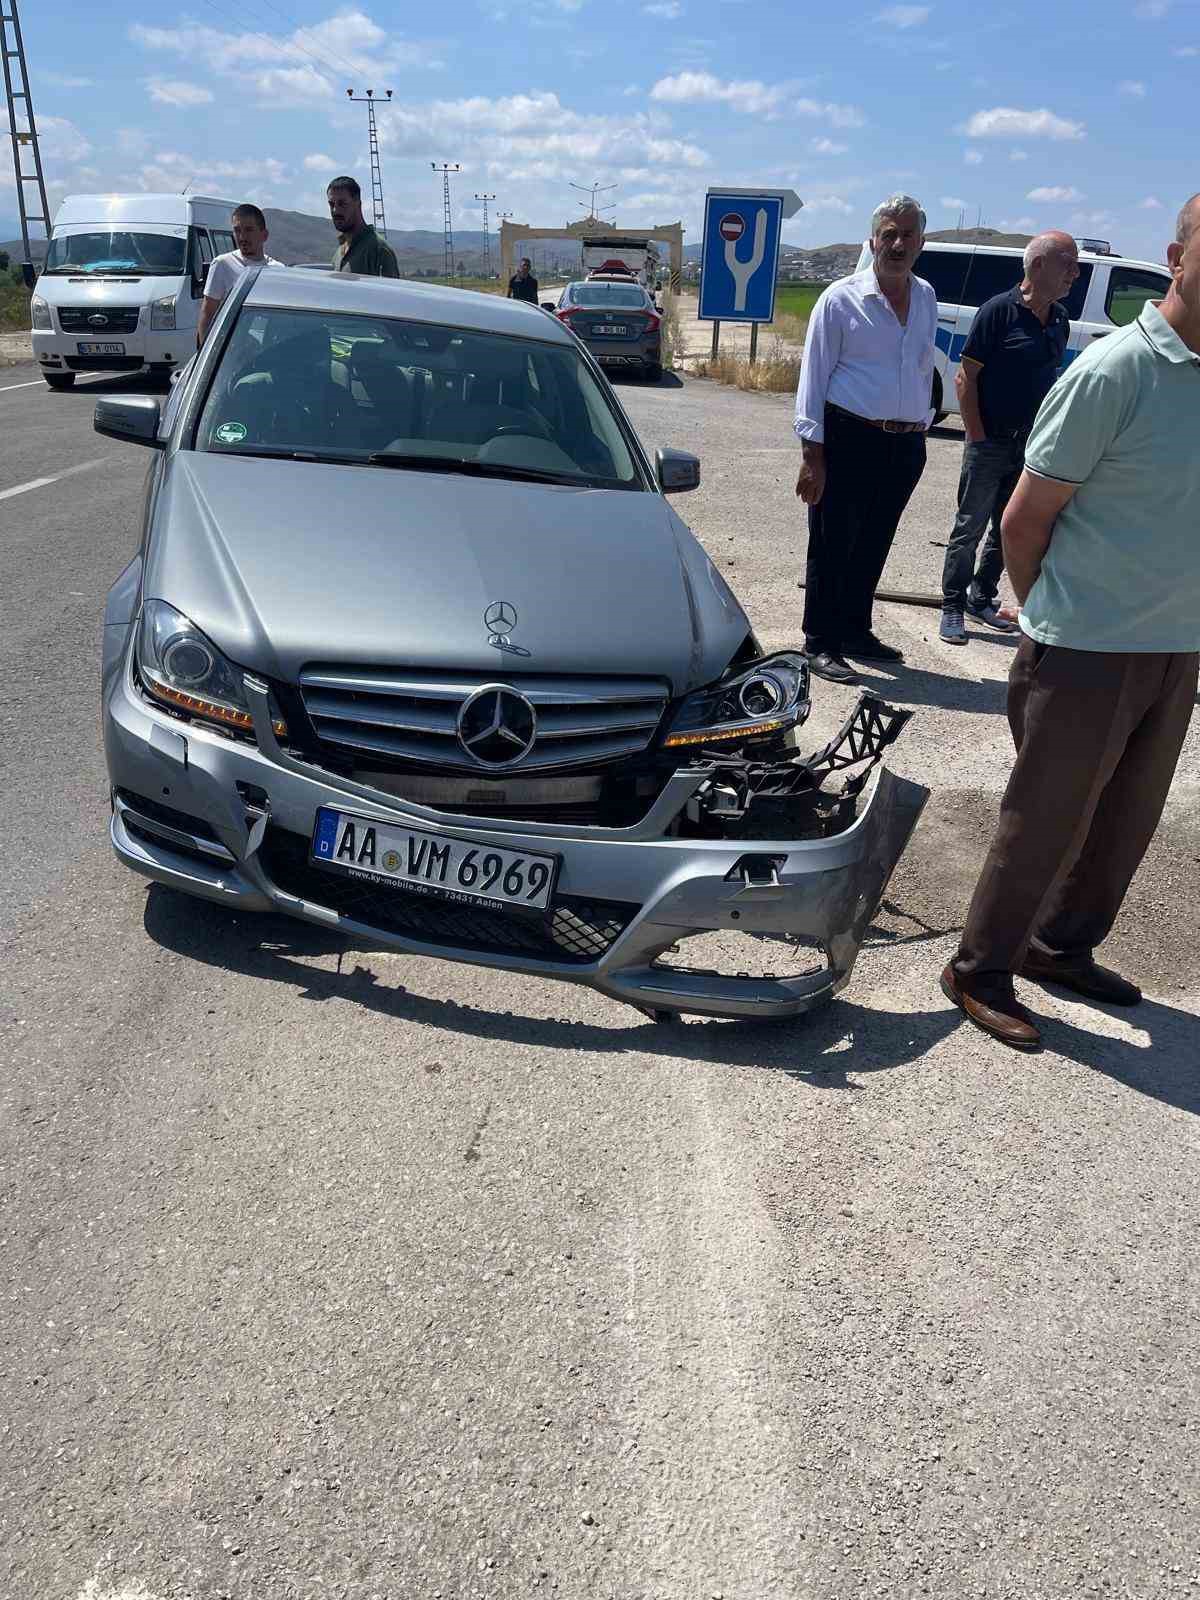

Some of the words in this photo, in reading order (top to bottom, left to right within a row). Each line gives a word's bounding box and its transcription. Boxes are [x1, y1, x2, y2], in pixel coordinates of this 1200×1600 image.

[320, 840, 329, 852] D
[336, 822, 376, 866] AA
[407, 836, 450, 882] VM
[457, 849, 550, 900] 6969
[476, 897, 504, 910] Aalen
